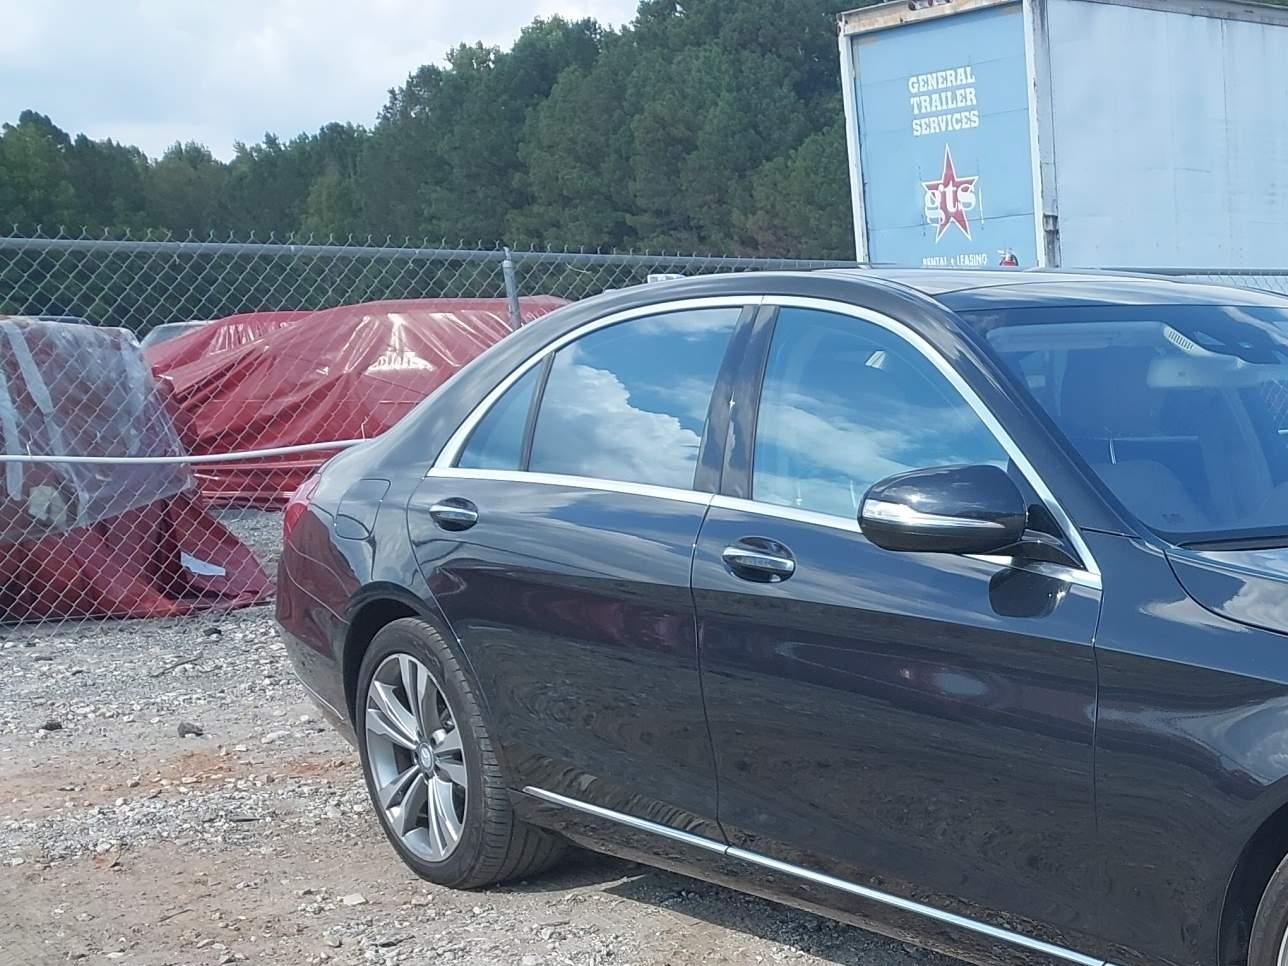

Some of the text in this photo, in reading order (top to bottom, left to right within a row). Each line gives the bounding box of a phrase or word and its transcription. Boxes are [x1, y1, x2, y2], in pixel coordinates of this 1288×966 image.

[908, 66, 976, 94] GENERAL
[910, 87, 977, 115] TRAILER
[912, 110, 980, 137] SERVICES
[924, 180, 976, 227] gts
[957, 253, 988, 267] LEASING
